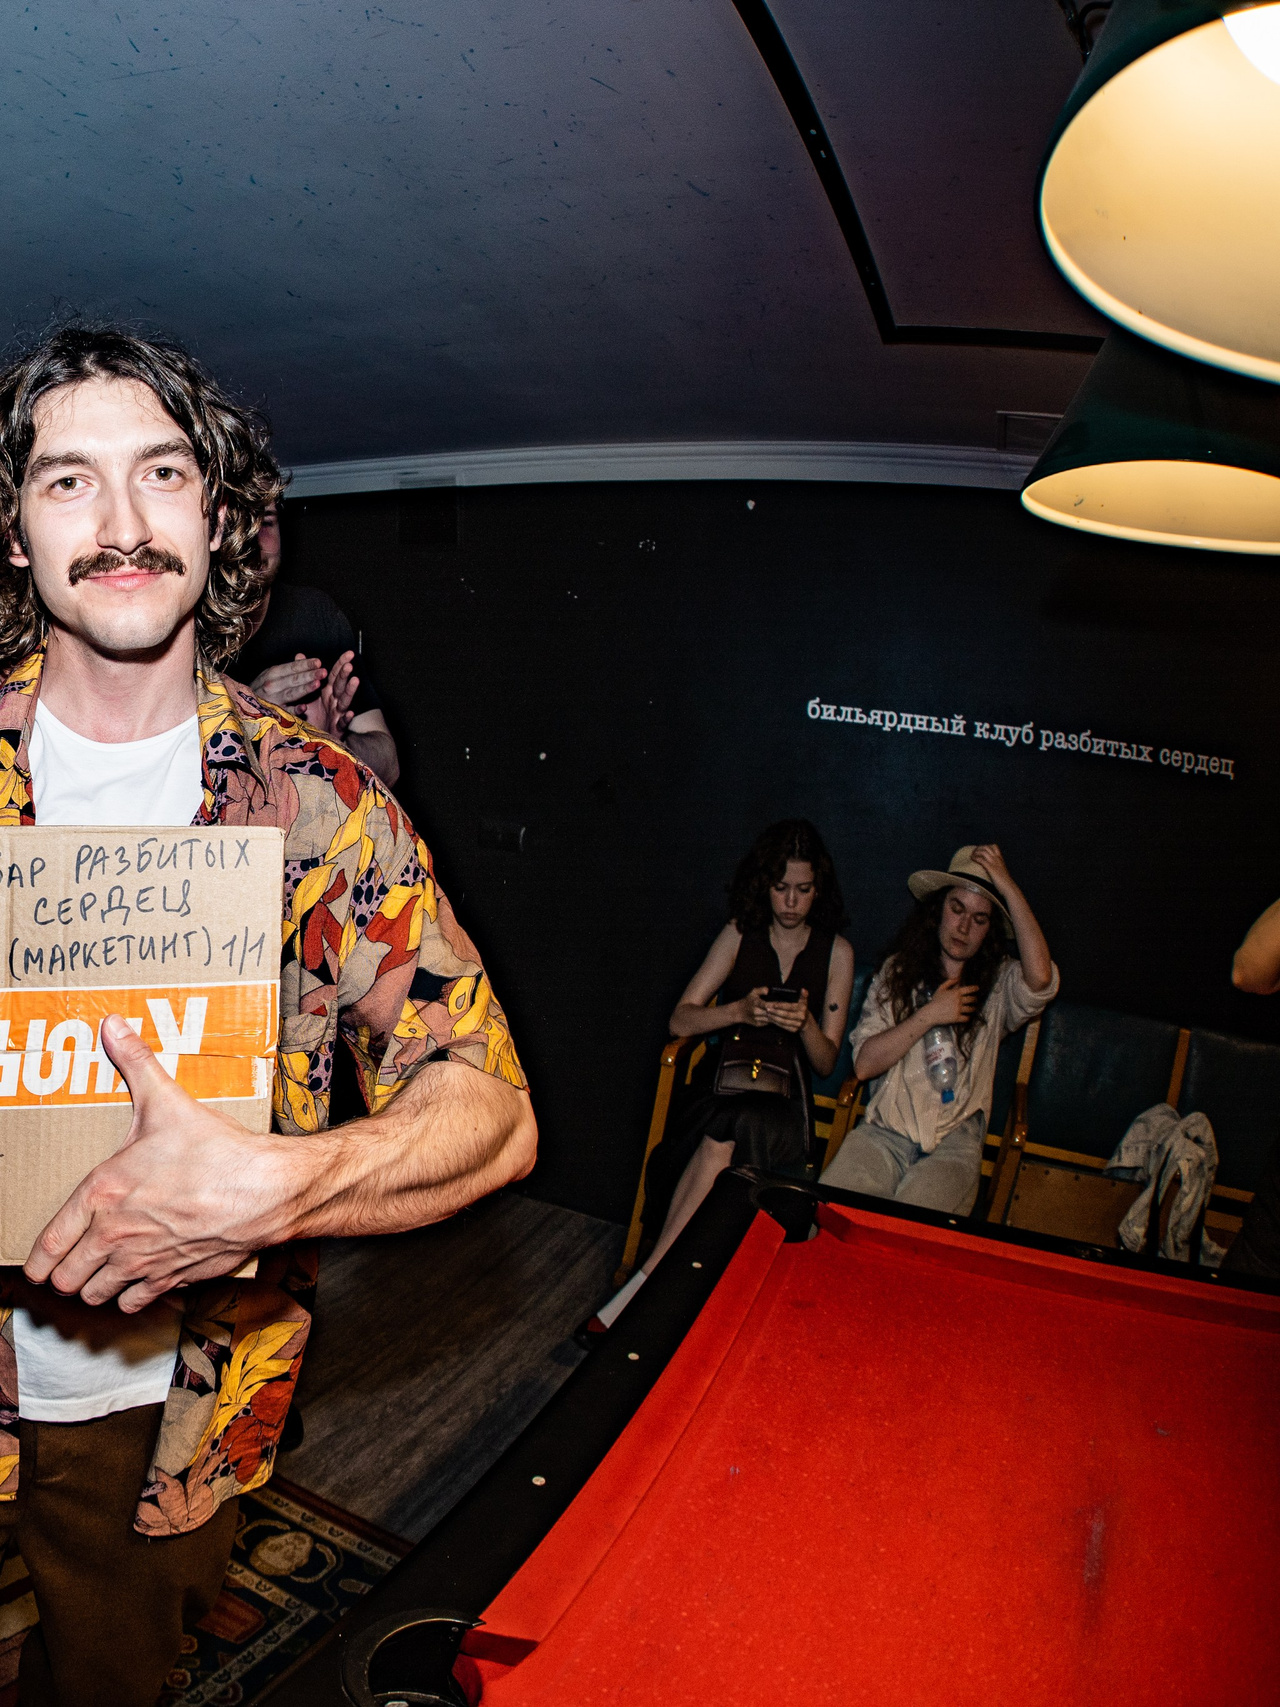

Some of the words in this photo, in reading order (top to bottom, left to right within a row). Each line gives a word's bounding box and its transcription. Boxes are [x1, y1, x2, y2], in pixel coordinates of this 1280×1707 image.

[807, 697, 966, 736] бильярдный
[973, 721, 1034, 747] клуб
[1038, 729, 1153, 763] разбитых
[1159, 748, 1235, 780] сердец
[75, 838, 250, 884] РАЗБИТЫХ
[33, 879, 191, 926] СЕРДЕЦ
[9, 926, 212, 981] (МАРКЕТИНГ)
[222, 926, 265, 975] 1/1
